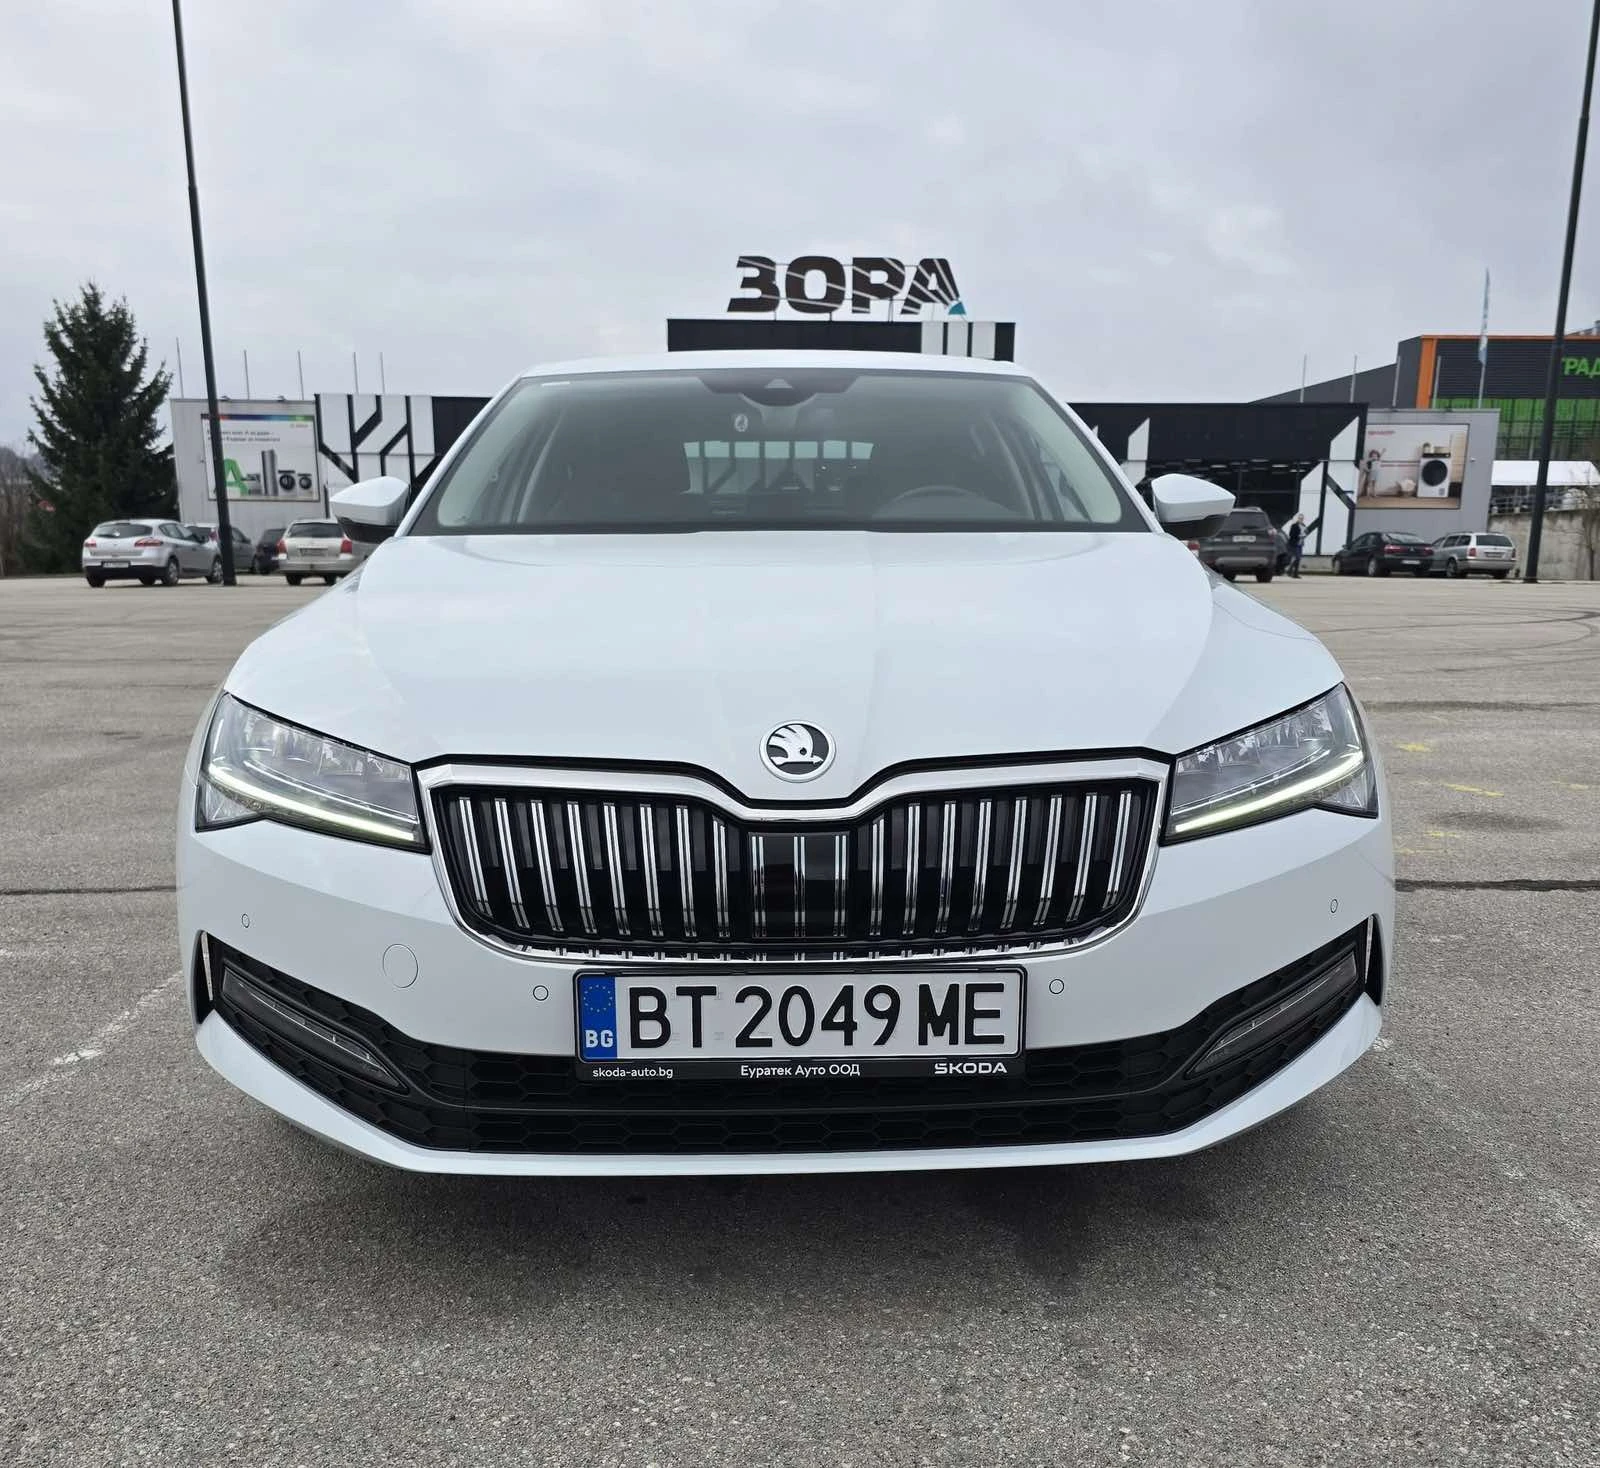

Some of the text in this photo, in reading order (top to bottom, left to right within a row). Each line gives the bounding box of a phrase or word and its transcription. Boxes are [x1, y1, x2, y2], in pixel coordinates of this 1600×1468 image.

[726, 255, 967, 316] ЗОРА
[1561, 357, 1600, 379] РАД
[628, 982, 1006, 1049] BT 2049 ME
[584, 1029, 613, 1049] BG
[592, 1066, 674, 1079] skoda-auto.bg
[740, 1063, 861, 1078] Еуратек Ауто ООД
